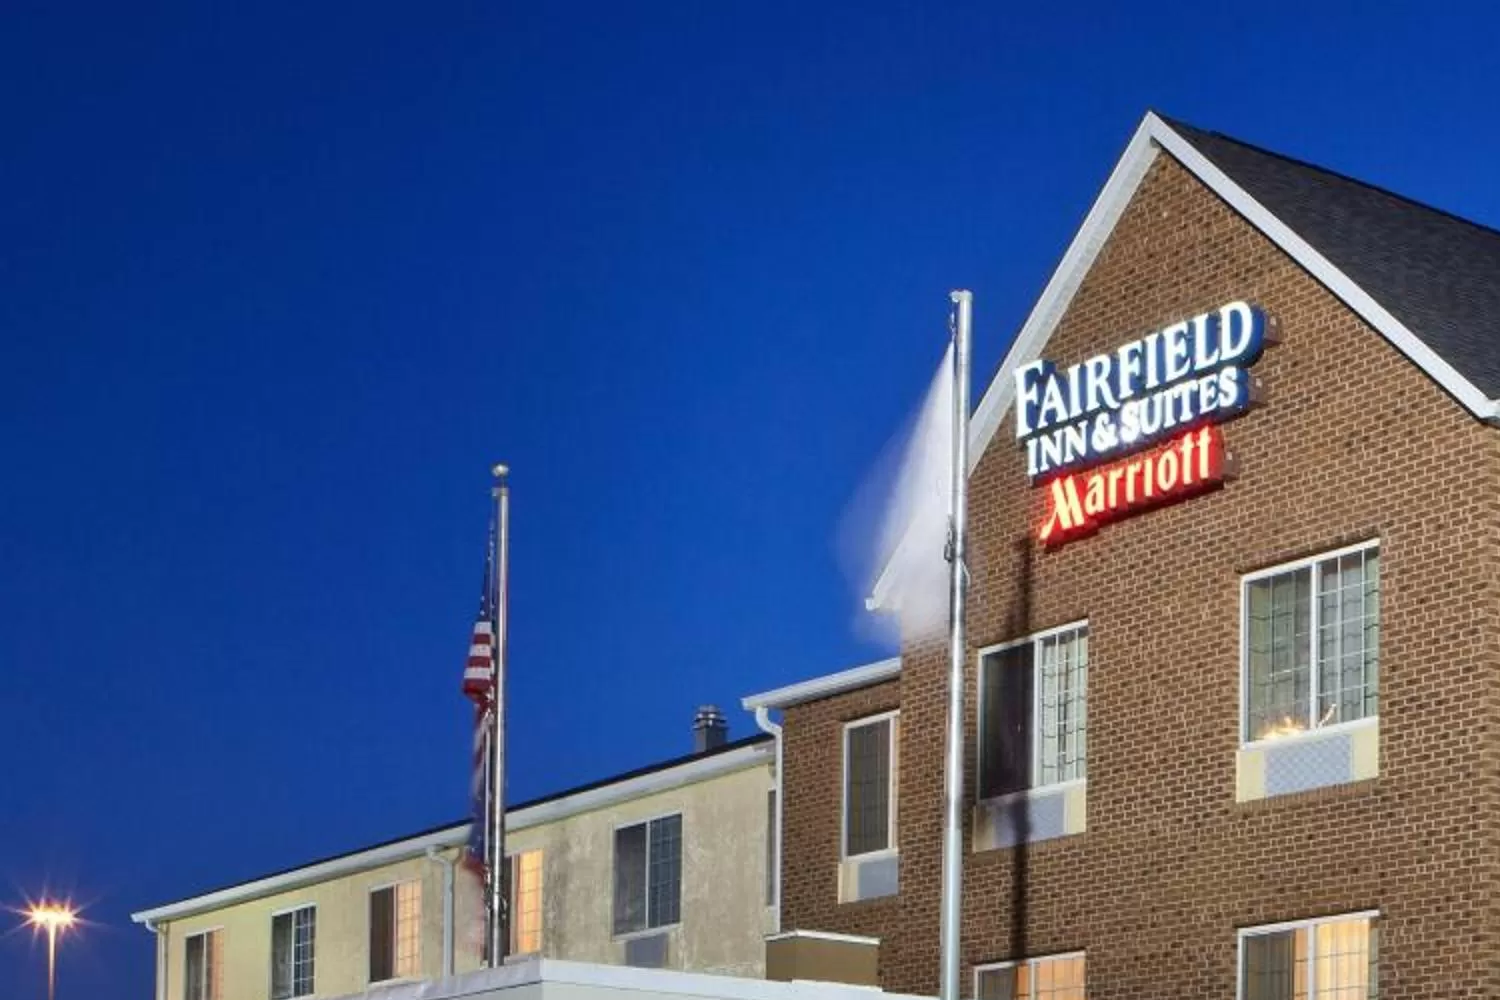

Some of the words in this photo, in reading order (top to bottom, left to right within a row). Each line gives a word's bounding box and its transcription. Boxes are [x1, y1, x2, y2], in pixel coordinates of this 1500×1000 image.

[1013, 300, 1252, 437] FAIRFIELD
[1027, 420, 1087, 476] INN
[1119, 366, 1238, 443] SUITES
[1040, 424, 1212, 539] Marriott
